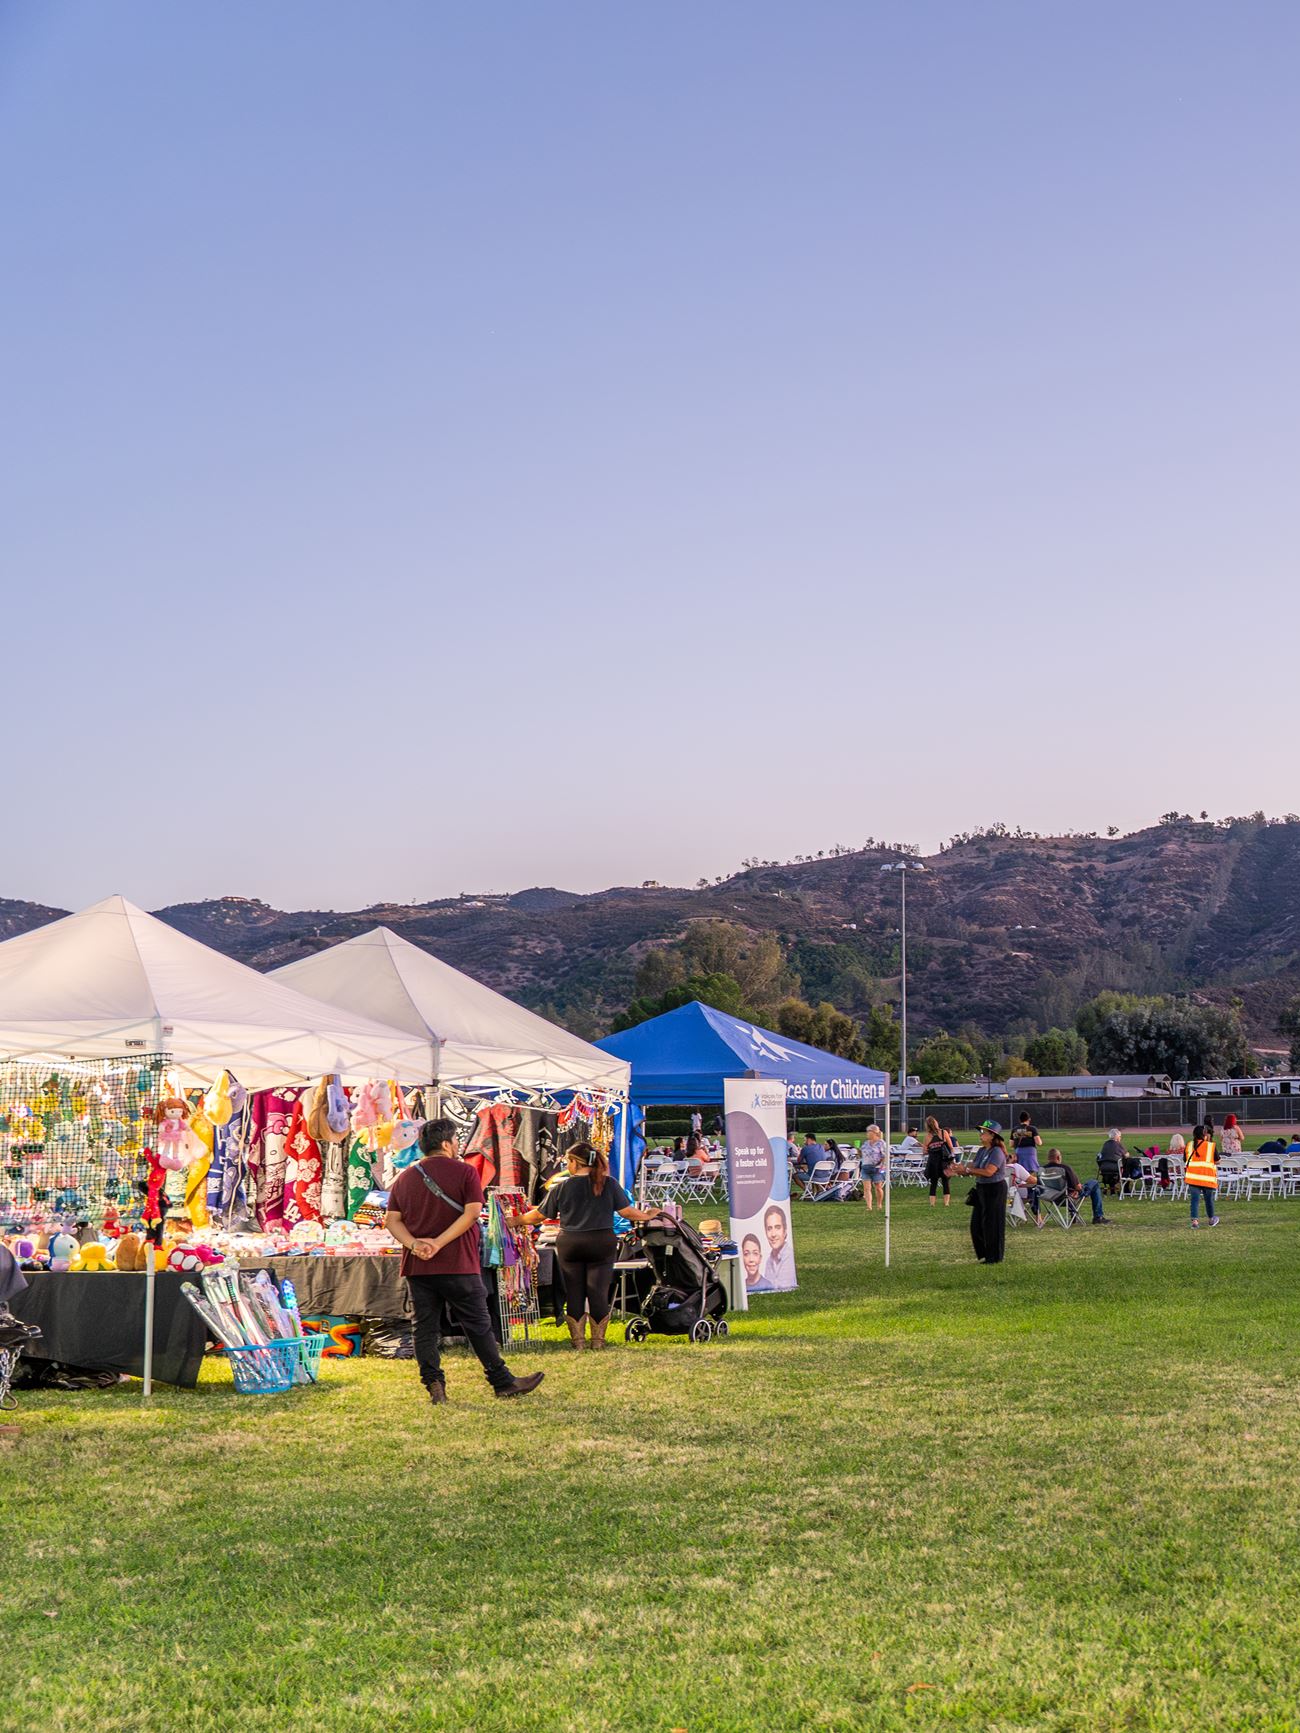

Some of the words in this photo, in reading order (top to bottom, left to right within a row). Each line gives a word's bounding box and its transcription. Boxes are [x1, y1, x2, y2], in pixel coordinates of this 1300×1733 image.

[810, 1079, 829, 1100] for
[830, 1078, 878, 1100] Children
[735, 1146, 749, 1157] Speak
[750, 1148, 756, 1156] up
[740, 1158, 754, 1167] foster
[755, 1158, 767, 1167] child
